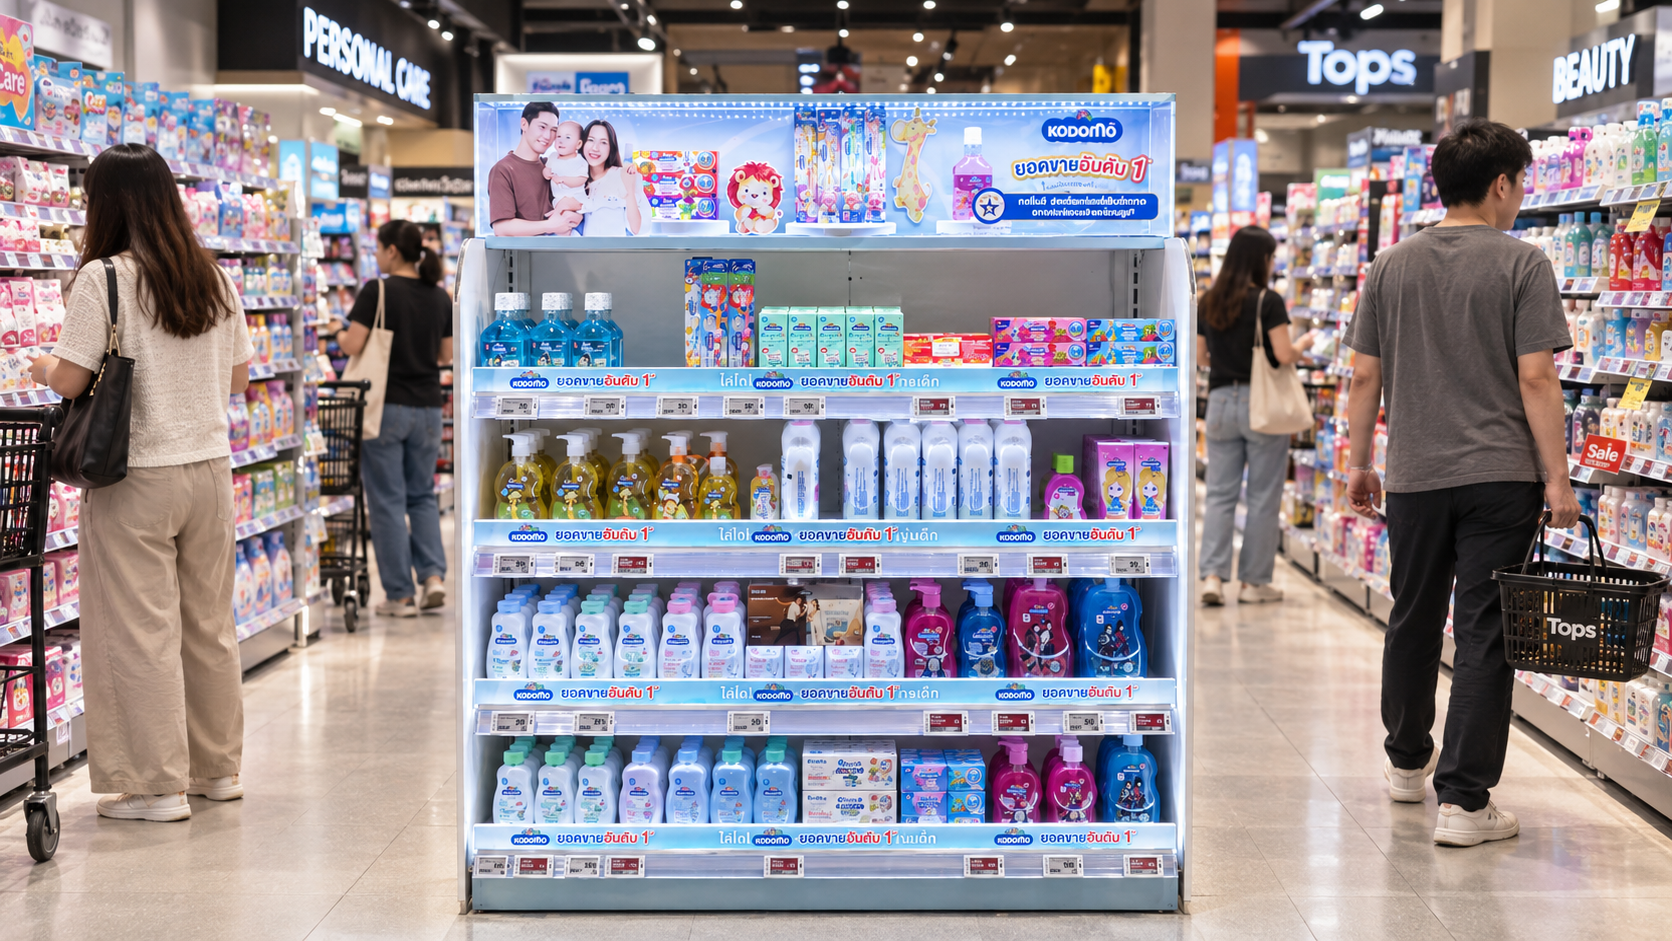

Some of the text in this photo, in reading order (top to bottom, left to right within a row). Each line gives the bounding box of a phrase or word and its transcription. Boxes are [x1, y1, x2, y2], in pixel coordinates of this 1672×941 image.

[303, 6, 431, 110] PERSONAL CARE
[1297, 40, 1417, 95] Tops
[1552, 33, 1636, 104] BEAUTY
[1587, 444, 1619, 462] Sale
[1547, 617, 1597, 641] Tops
